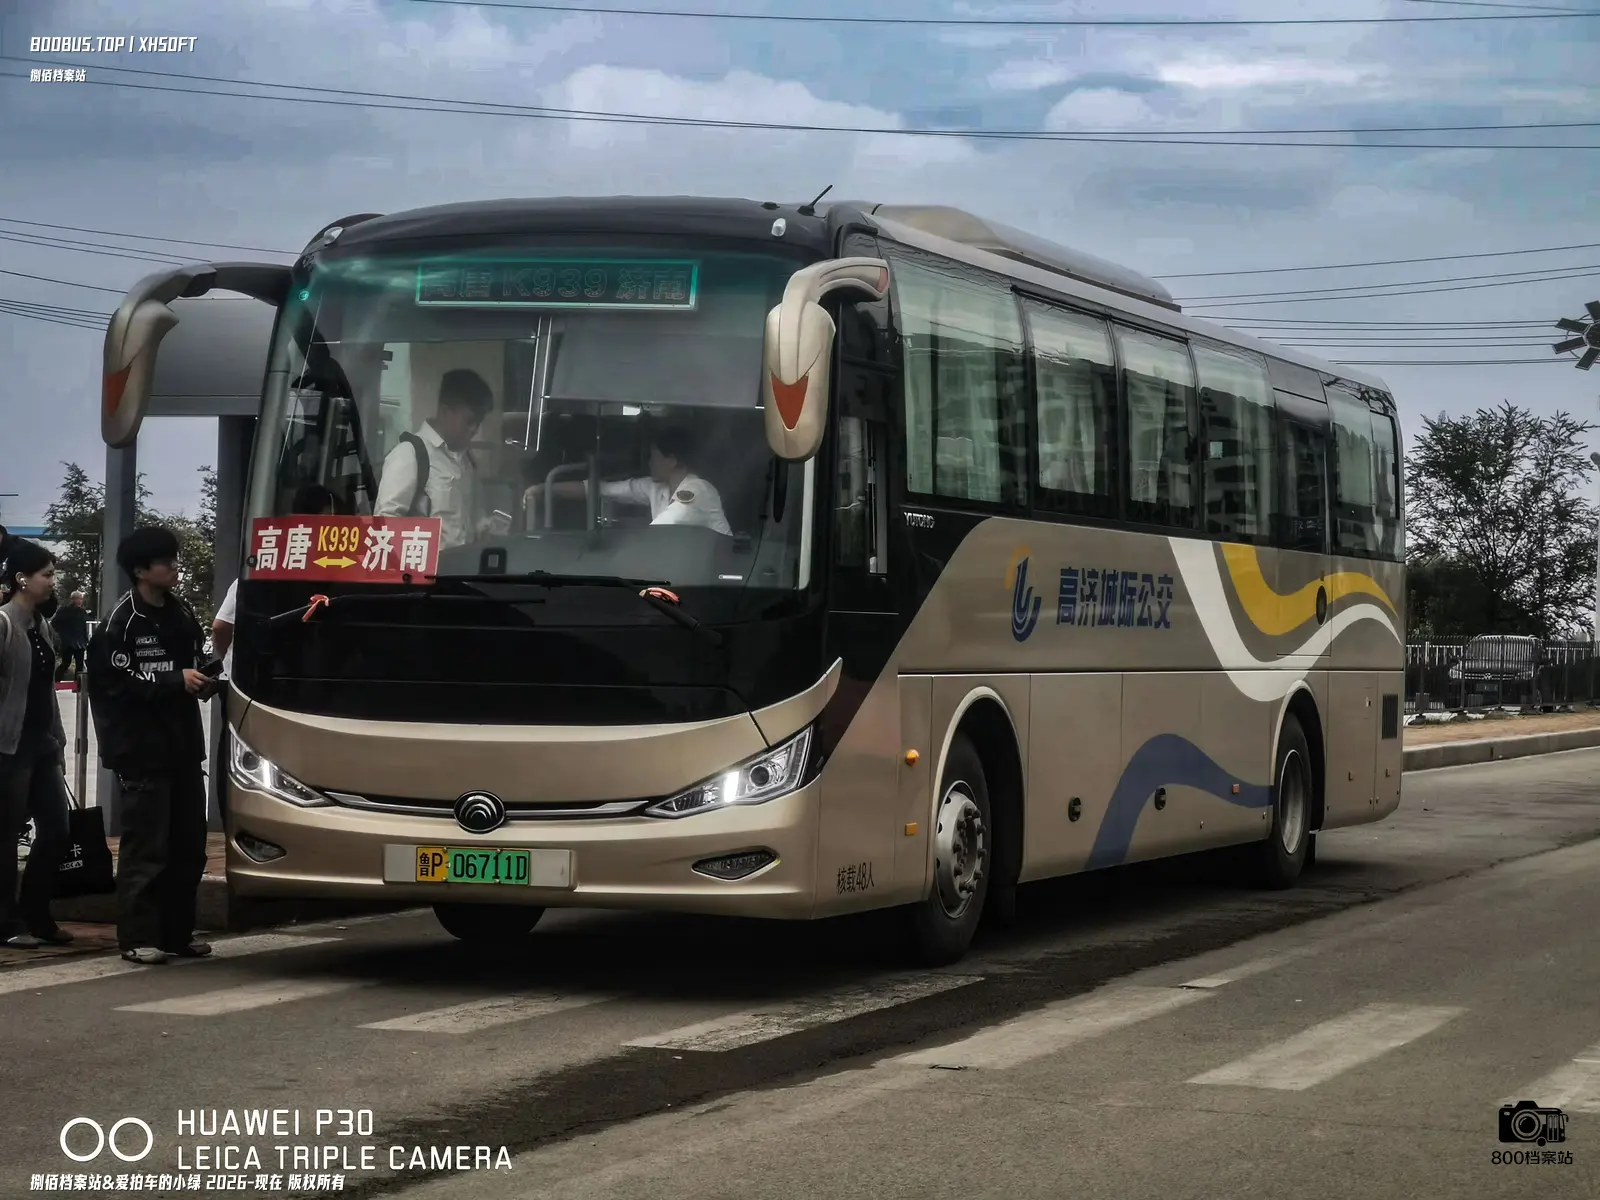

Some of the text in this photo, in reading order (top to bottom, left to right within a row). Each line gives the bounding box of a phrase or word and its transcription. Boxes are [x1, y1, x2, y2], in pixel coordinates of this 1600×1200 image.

[502, 268, 608, 298] K939
[255, 524, 432, 573] 高唐 K939 济南
[1056, 566, 1174, 629] 高济城际公交
